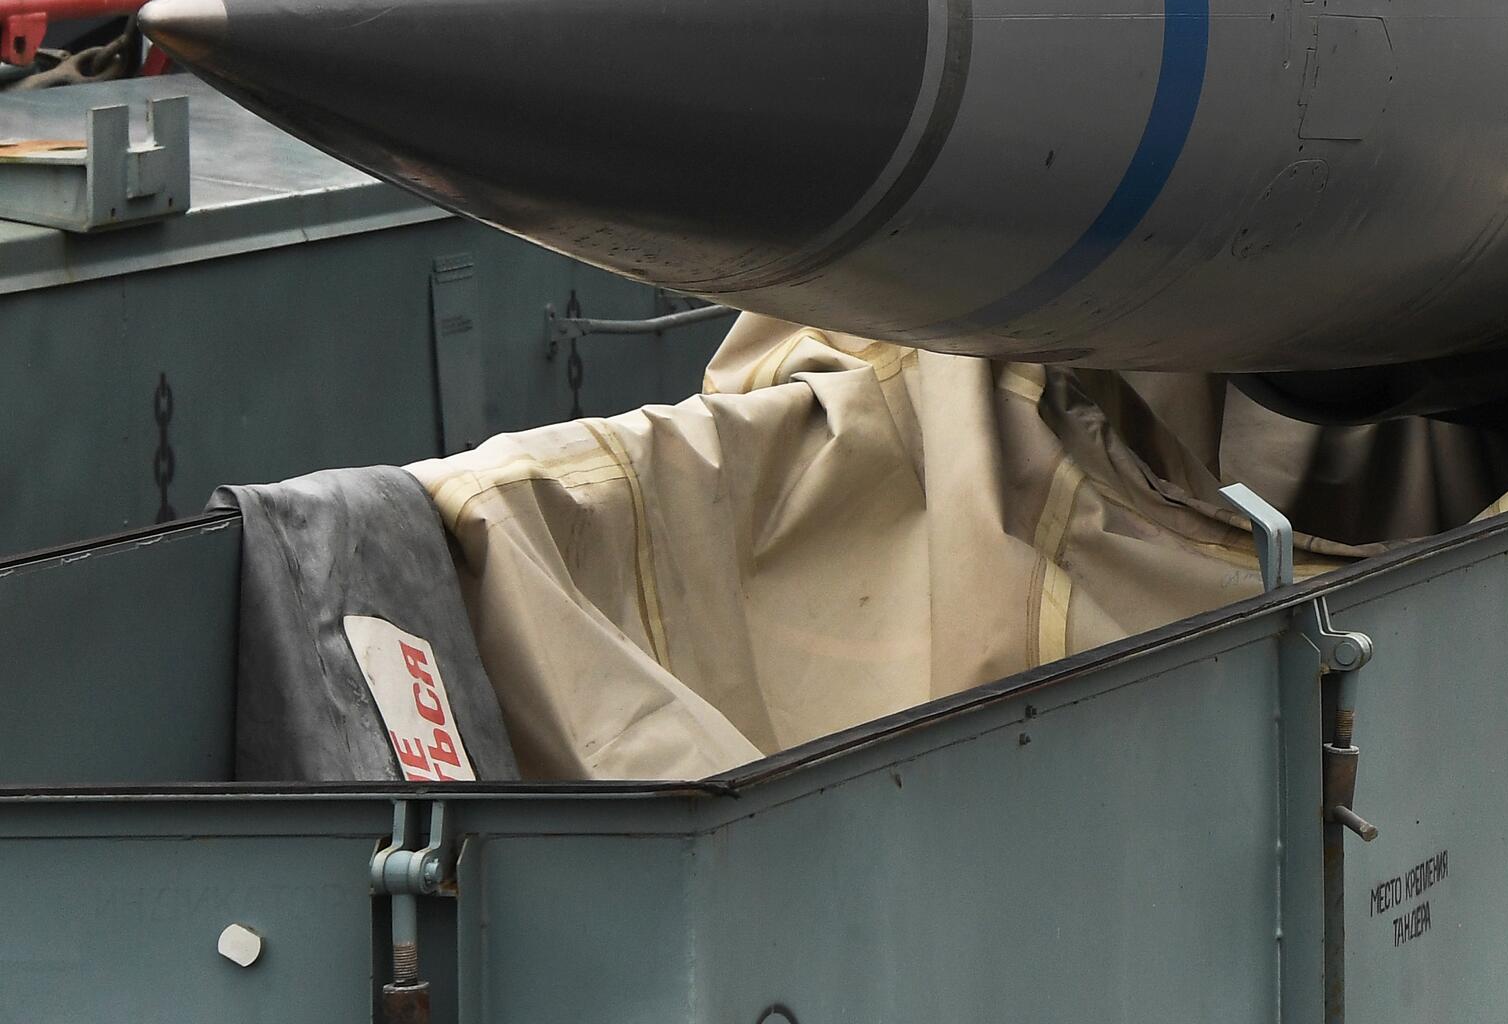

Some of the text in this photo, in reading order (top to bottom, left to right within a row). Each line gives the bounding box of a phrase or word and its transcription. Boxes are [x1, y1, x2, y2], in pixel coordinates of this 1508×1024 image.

[1370, 849, 1449, 917] МЕСТО КРЕПЛЕНИЯ
[1393, 901, 1432, 947] ТАНДЕРА
